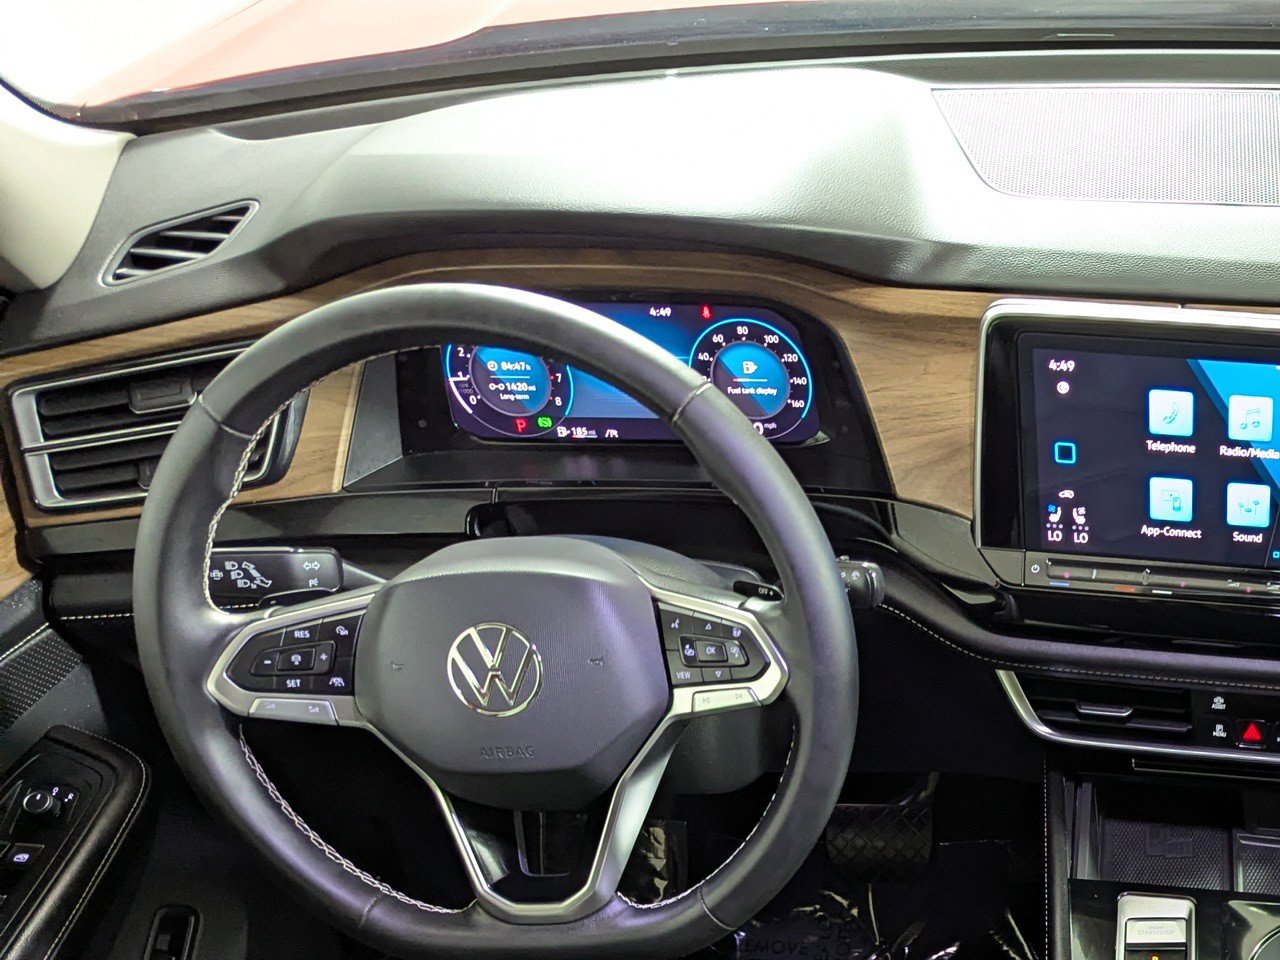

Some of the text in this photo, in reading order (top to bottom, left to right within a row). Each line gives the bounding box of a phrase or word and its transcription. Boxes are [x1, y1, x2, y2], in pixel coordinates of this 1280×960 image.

[649, 306, 672, 317] 4:49
[736, 326, 749, 335] 80
[712, 334, 724, 343] 60
[763, 335, 779, 344] 100
[457, 347, 465, 357] 2
[698, 352, 709, 361] 40
[783, 353, 799, 363] 120
[1048, 358, 1076, 372] 4:49
[555, 373, 562, 383] 7
[792, 376, 807, 385] 140
[505, 382, 528, 391] 1420
[727, 386, 778, 396] Fuel tank display
[468, 395, 477, 405] 0
[555, 396, 563, 406] 8
[791, 400, 805, 408] 160
[1145, 439, 1197, 454] Telephone
[1218, 444, 1280, 461] Radio/Media
[1047, 530, 1063, 541] LO
[1140, 524, 1203, 539] App-Connect
[1232, 530, 1263, 543] Sound
[1073, 532, 1089, 544] LO
[294, 629, 311, 639] RES
[705, 646, 717, 655] OK
[675, 671, 692, 680] VIEW
[286, 679, 302, 688] SET
[479, 745, 535, 760] AIRBAG
